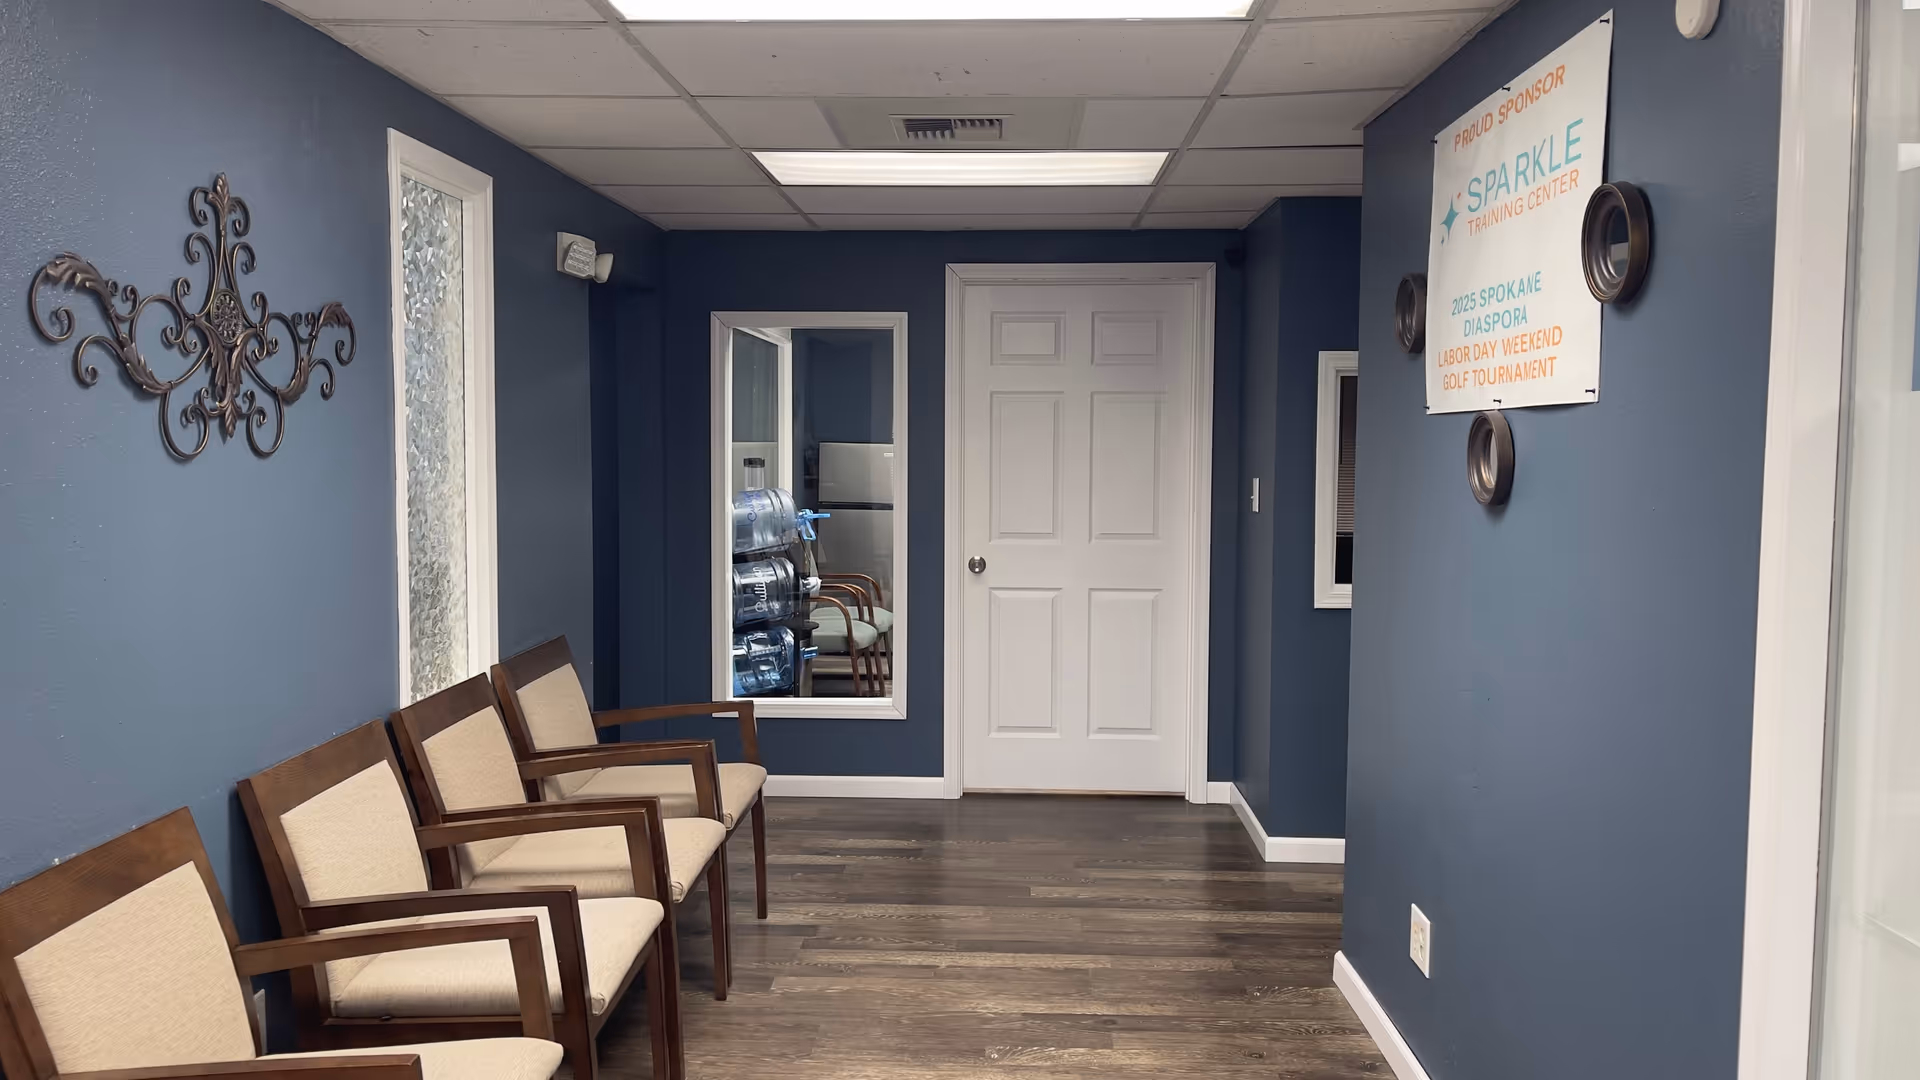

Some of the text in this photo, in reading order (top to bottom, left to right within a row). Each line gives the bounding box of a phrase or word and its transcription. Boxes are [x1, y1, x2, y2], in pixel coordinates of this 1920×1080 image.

[1454, 64, 1567, 153] PROUD SPONSOR
[1466, 117, 1584, 213] SPARKLE
[1467, 168, 1580, 237] TRAINING CENTER
[1451, 271, 1543, 317] 2025 SPOKANE
[1463, 304, 1528, 338] DIASPORA
[1438, 325, 1563, 368] LABOR DAY WEEKEND
[1443, 356, 1557, 391] GOLF TOURNAMENT
